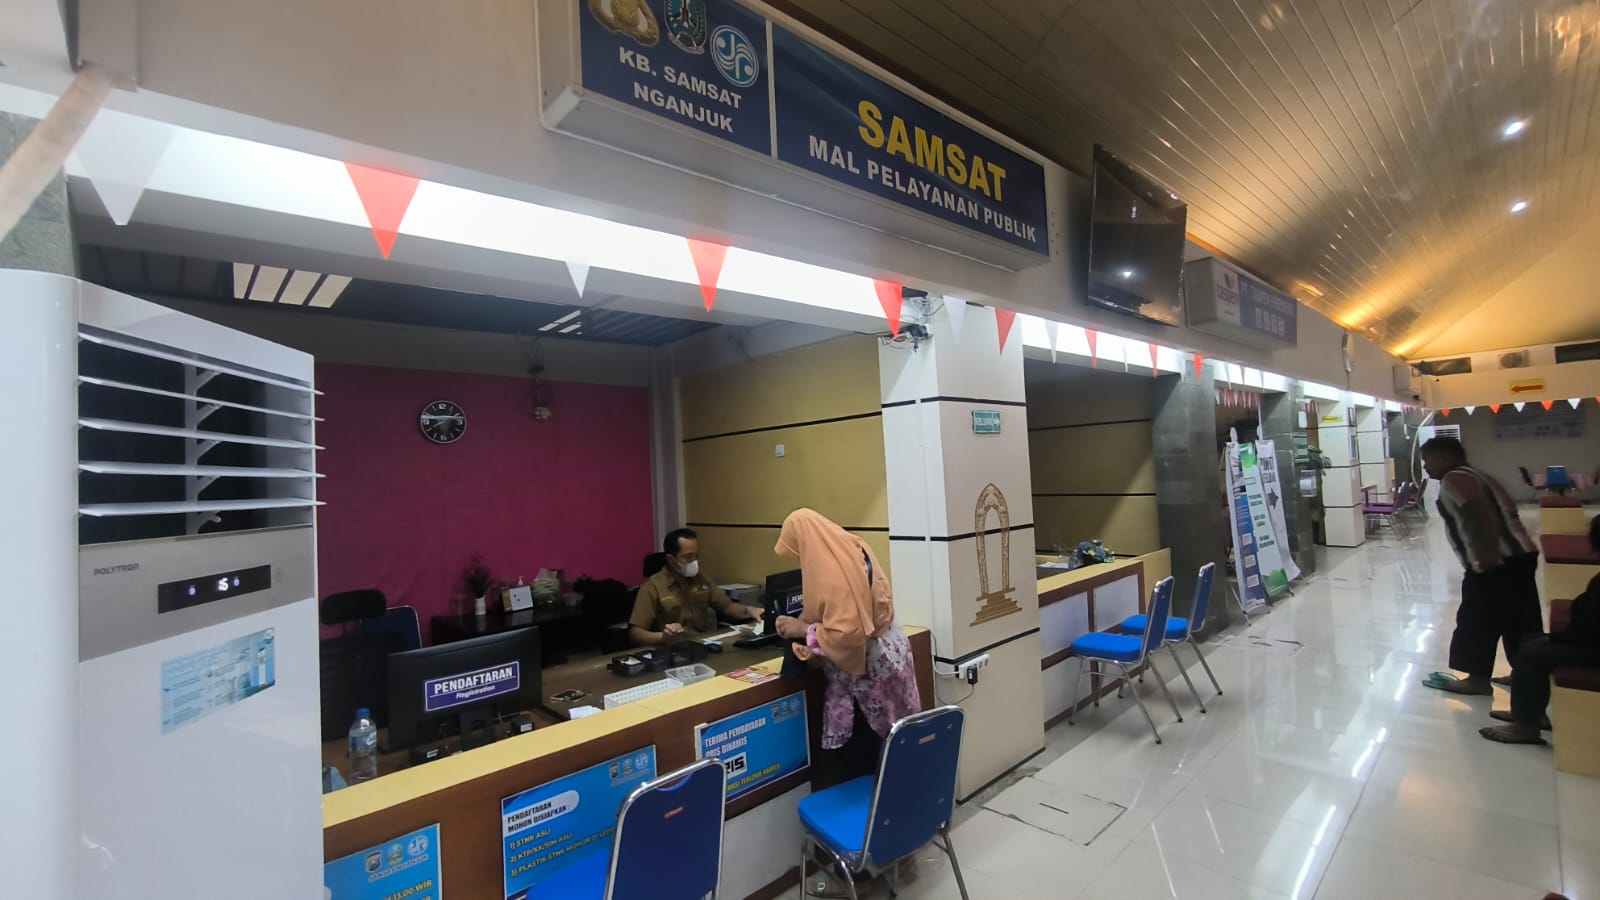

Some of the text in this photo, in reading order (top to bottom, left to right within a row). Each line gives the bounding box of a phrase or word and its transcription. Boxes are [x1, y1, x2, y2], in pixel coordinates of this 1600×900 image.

[618, 46, 742, 110] KB. SAMSAT
[633, 84, 734, 134] NGANJUK
[857, 100, 1007, 202] SAMSAT
[808, 134, 1038, 244] MAL PELAYANAN PUBLIK
[434, 666, 513, 694] PENDAFTARAN
[456, 685, 496, 700] Registration
[704, 731, 728, 748] TERIMA
[728, 717, 767, 739] PEMBAYARAN
[722, 736, 748, 753] DINAMIS
[507, 801, 552, 824] PENDAFTARAN
[508, 805, 567, 833] MOHON DISIAPKAN
[516, 834, 534, 847] STNK
[536, 828, 551, 839] ASLI
[558, 832, 573, 842] ASLI
[518, 856, 547, 874] PLASTIK
[548, 849, 566, 860] STNK
[415, 879, 433, 893] WIB
